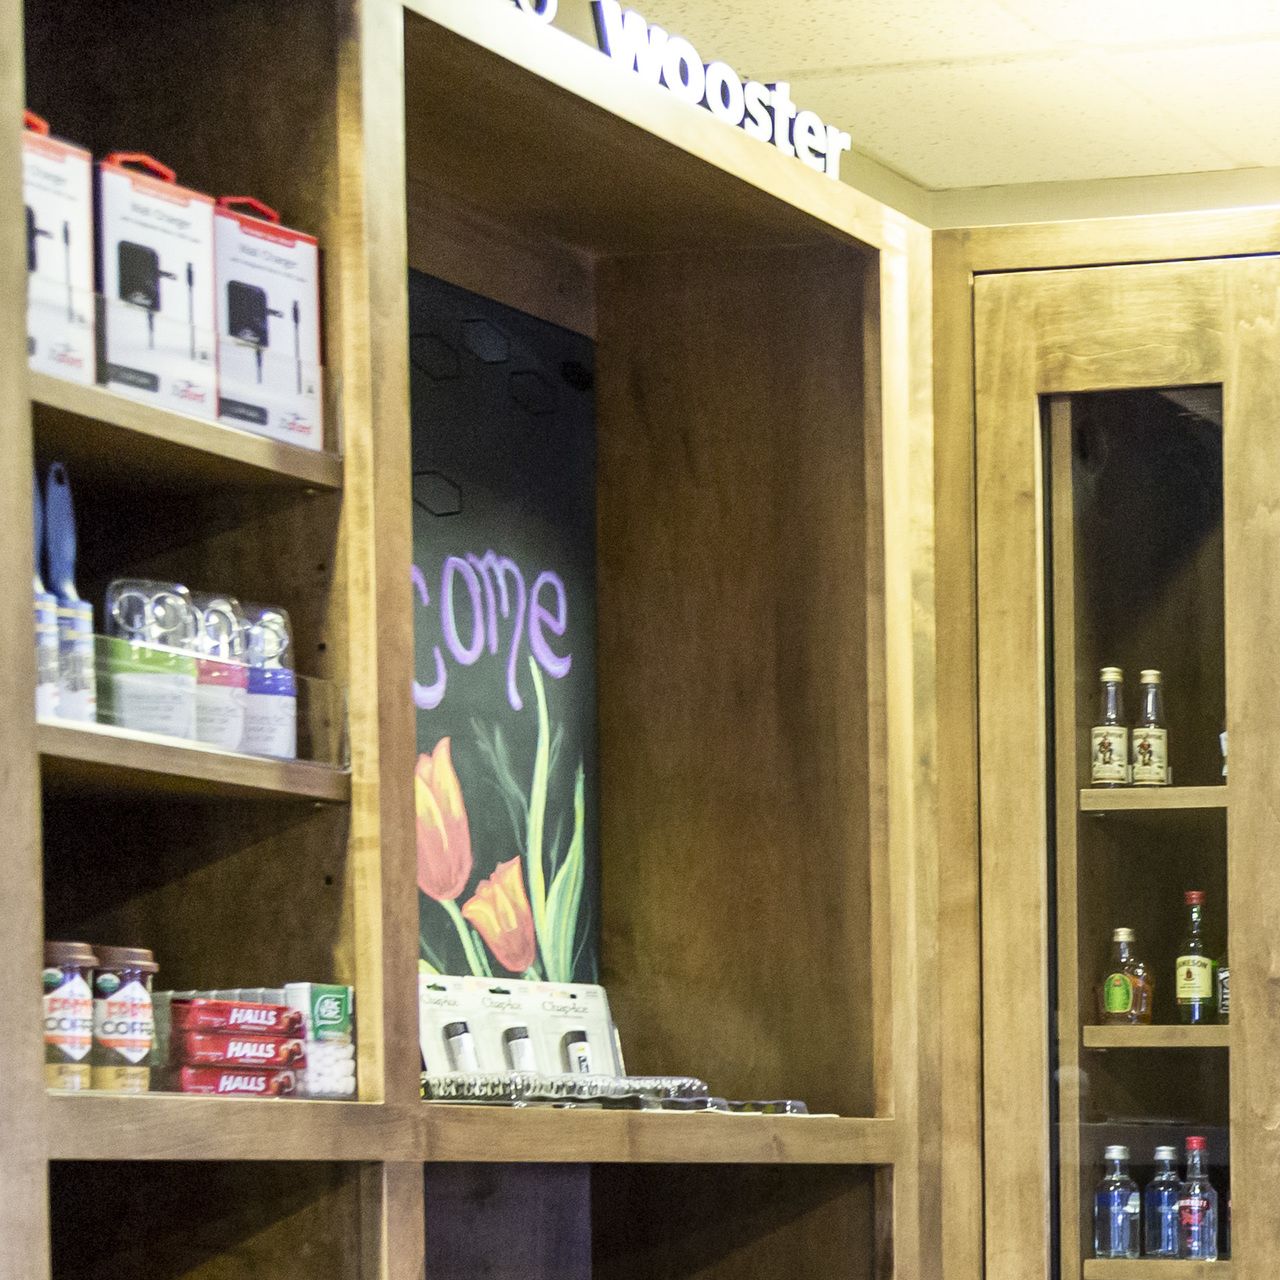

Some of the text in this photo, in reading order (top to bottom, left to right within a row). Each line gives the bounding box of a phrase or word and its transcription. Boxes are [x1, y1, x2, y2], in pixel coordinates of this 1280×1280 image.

[597, 0, 852, 181] wooster
[229, 1007, 277, 1026] HALLS
[226, 1041, 275, 1059] HALLS
[218, 1074, 266, 1092] HALLS
